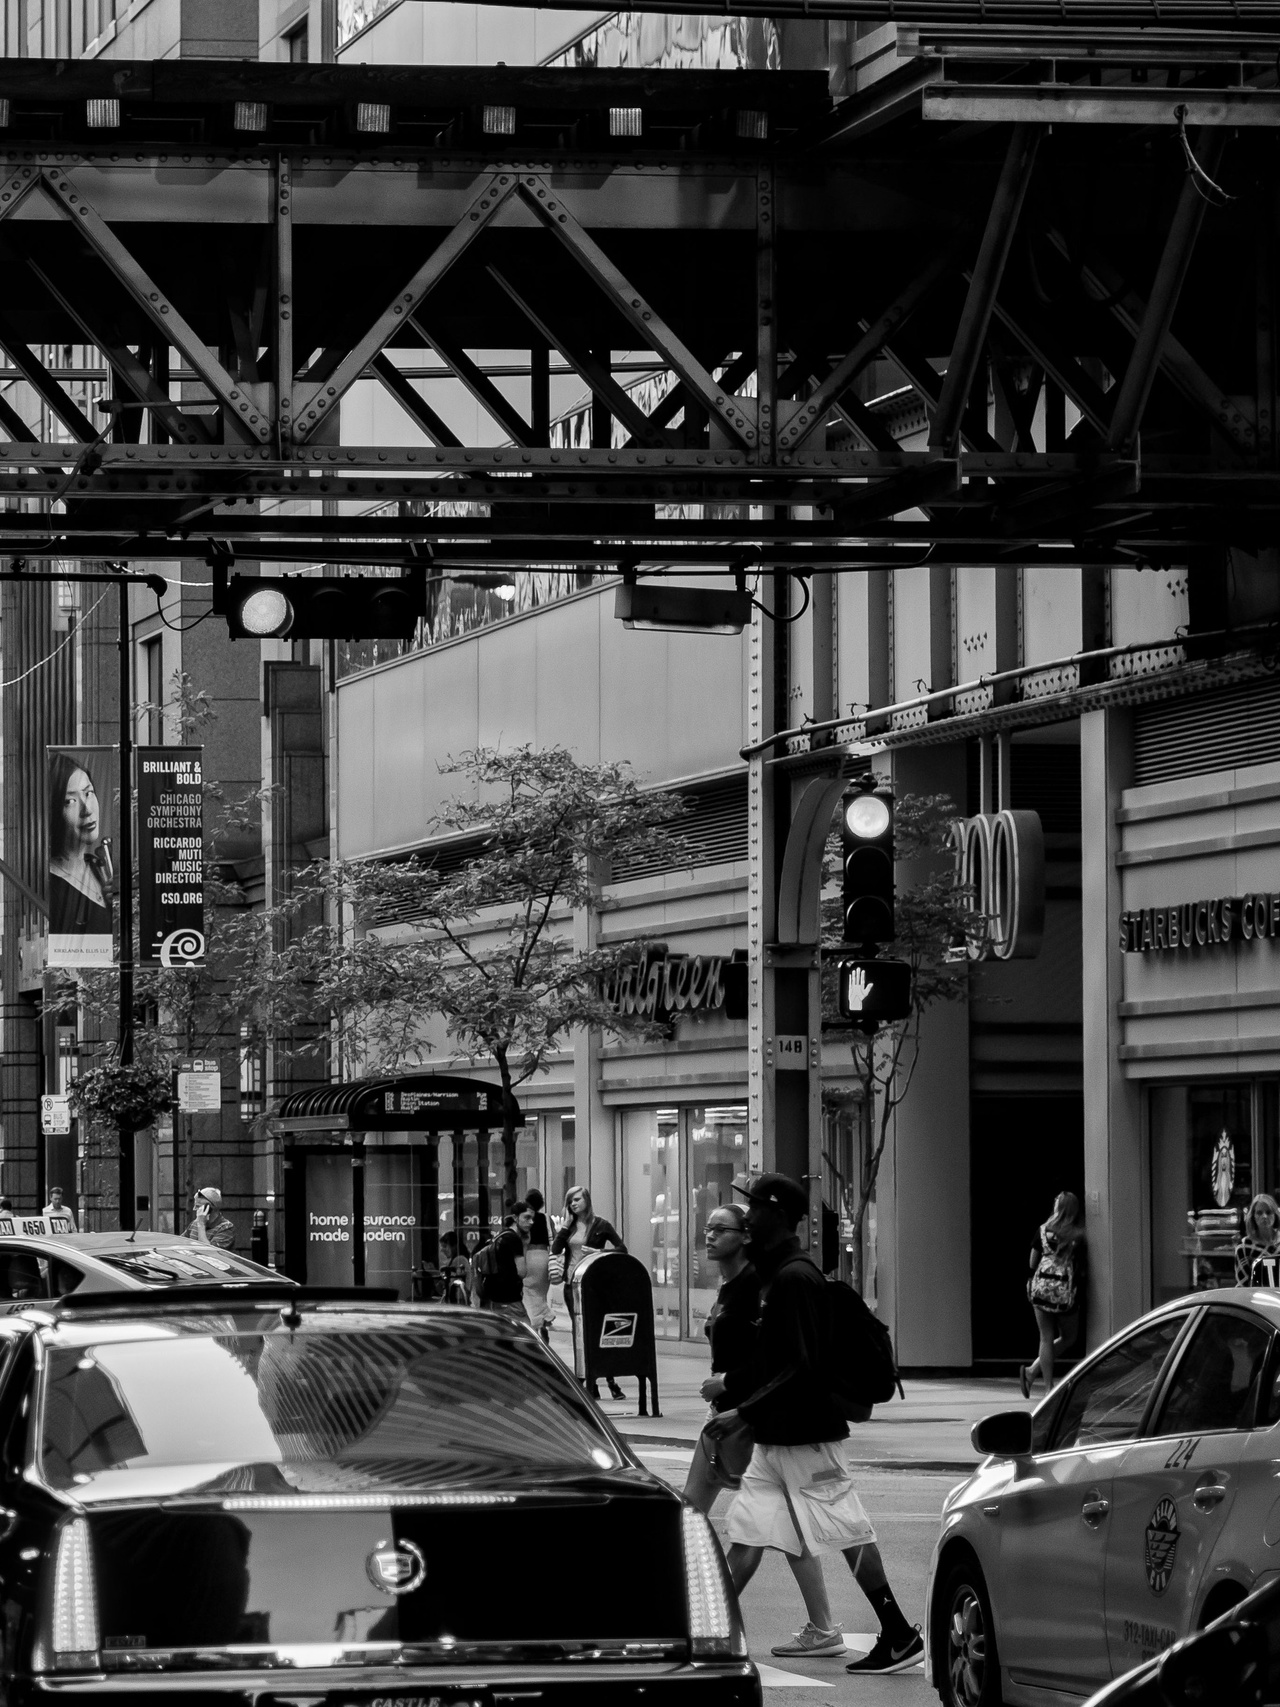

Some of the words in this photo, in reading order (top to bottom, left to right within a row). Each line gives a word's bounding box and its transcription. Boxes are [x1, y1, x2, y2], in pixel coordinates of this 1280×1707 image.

[143, 761, 191, 773] BRILLIANT
[194, 761, 202, 773] &
[176, 773, 202, 785] BOLD
[160, 794, 202, 805] CHICAGO
[150, 805, 202, 817] SYMPHONY
[147, 817, 202, 828] ORCHESTRA
[153, 837, 202, 849] RICCARDO
[178, 849, 202, 860] MUTI
[171, 861, 202, 872] MUSIC
[155, 872, 202, 884] DIRECTOR
[161, 892, 203, 904] CSO.ORG
[1119, 898, 1232, 953] STARBUCKS
[310, 1212, 349, 1226] home
[352, 1213, 416, 1226] isurance
[22, 1220, 46, 1235] 4650
[50, 1218, 70, 1233] TAXI
[310, 1228, 350, 1242] made
[1164, 1438, 1202, 1470] 224
[371, 1696, 441, 1707] CASTLE
